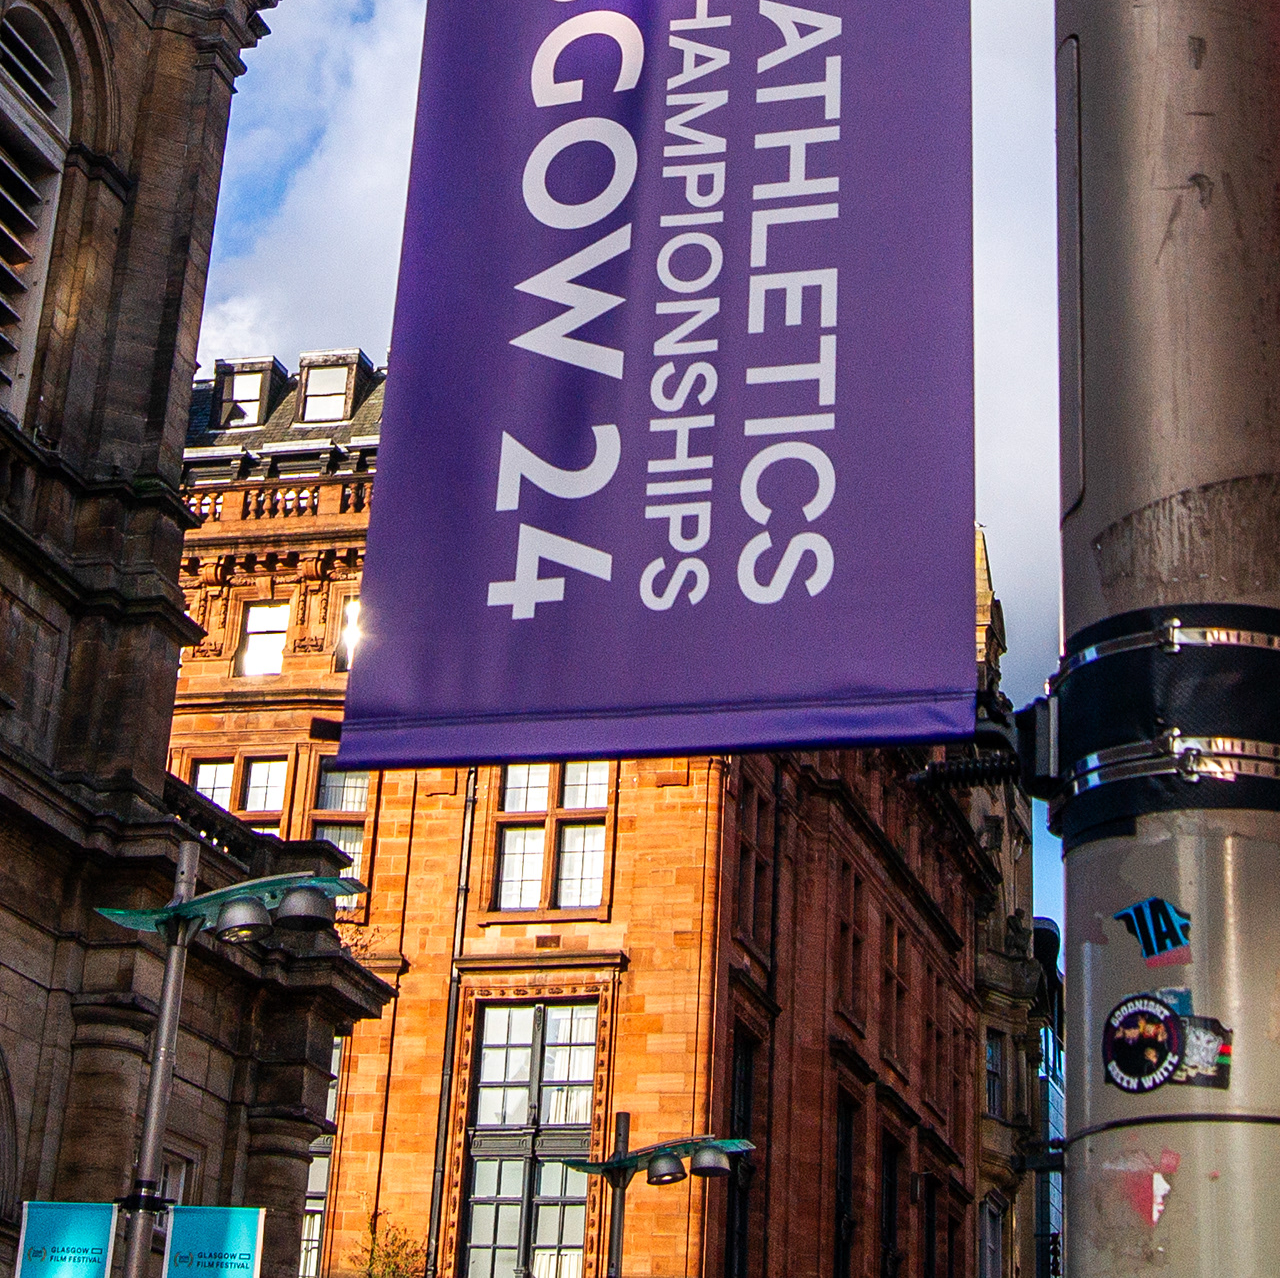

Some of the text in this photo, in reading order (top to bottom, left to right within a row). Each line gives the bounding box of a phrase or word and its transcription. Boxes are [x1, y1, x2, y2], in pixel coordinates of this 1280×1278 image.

[487, 424, 621, 620] 24
[1141, 1052, 1179, 1089] WHITE
[50, 1246, 90, 1254] GLASGOW
[49, 1254, 101, 1263] FILM FESTIVAL
[197, 1251, 238, 1259] GLASGOW
[196, 1260, 250, 1269] FILM FESTIVAL
